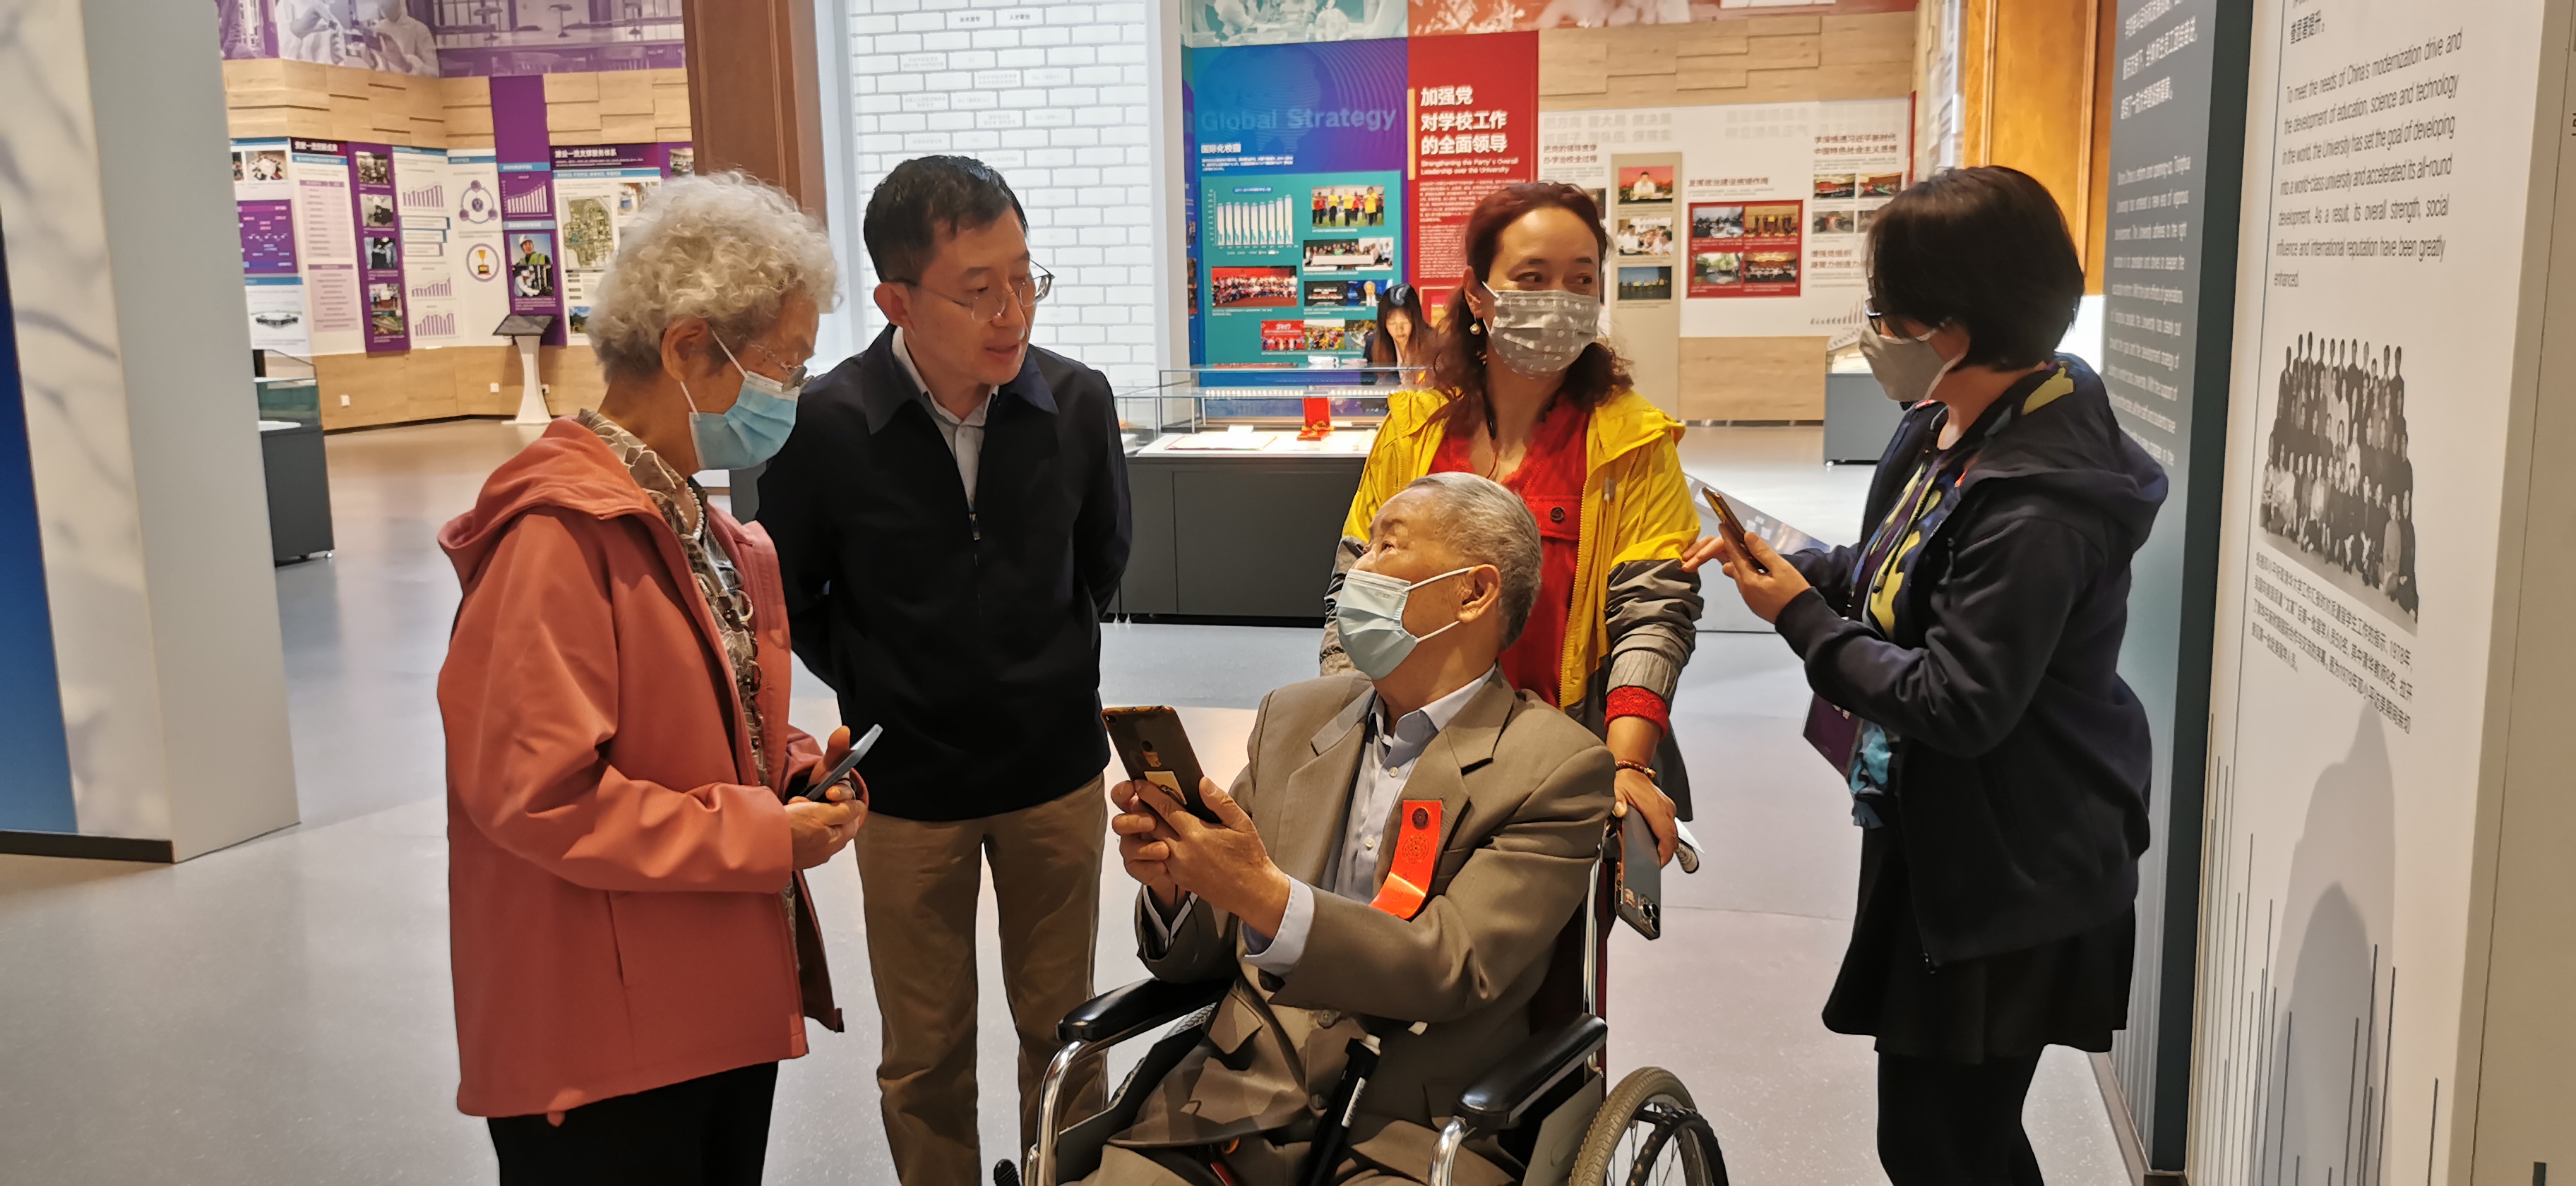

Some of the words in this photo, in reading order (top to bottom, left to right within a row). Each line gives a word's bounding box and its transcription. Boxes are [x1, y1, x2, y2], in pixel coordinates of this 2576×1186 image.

[2294, 83, 2308, 101] meet
[2308, 78, 2318, 97] the
[2319, 71, 2337, 94] needs
[2339, 66, 2347, 88] of
[2347, 61, 2370, 85] China's
[2371, 44, 2421, 77] modernization
[2423, 35, 2443, 61] drive
[2445, 25, 2463, 54] and
[1420, 85, 1474, 107] 加强党
[2284, 116, 2292, 136] the
[2294, 108, 2327, 132] development
[2329, 103, 2337, 124] of
[2371, 91, 2397, 113] science
[2399, 81, 2415, 106] and
[2416, 72, 2460, 102] technology
[1200, 108, 1277, 131] Global
[1286, 107, 1397, 131] Strategy
[1420, 109, 1508, 132] 对学校工作
[1421, 133, 1508, 156] 的全面领导
[2313, 141, 2322, 160] the
[2322, 135, 2350, 158] University
[2351, 133, 2363, 152] has
[2364, 130, 2375, 150] set
[2375, 128, 2386, 148] the
[2387, 122, 2404, 150] goal
[2404, 119, 2414, 143] of
[2414, 112, 2455, 143] developing
[2353, 165, 2366, 187] and
[2366, 159, 2407, 185] accelerated
[2407, 158, 2416, 180] its
[2416, 152, 2453, 179] all-round
[2314, 205, 2322, 224] As
[2325, 208, 2330, 223] a
[2365, 198, 2387, 221] overall
[2390, 196, 2421, 223] strength,
[2426, 193, 2450, 217] social
[2298, 238, 2310, 256] and
[2310, 237, 2346, 256] international
[2347, 236, 2378, 260] reputation
[2380, 235, 2397, 257] have
[2399, 234, 2417, 257] been
[2419, 234, 2446, 263] greatly
